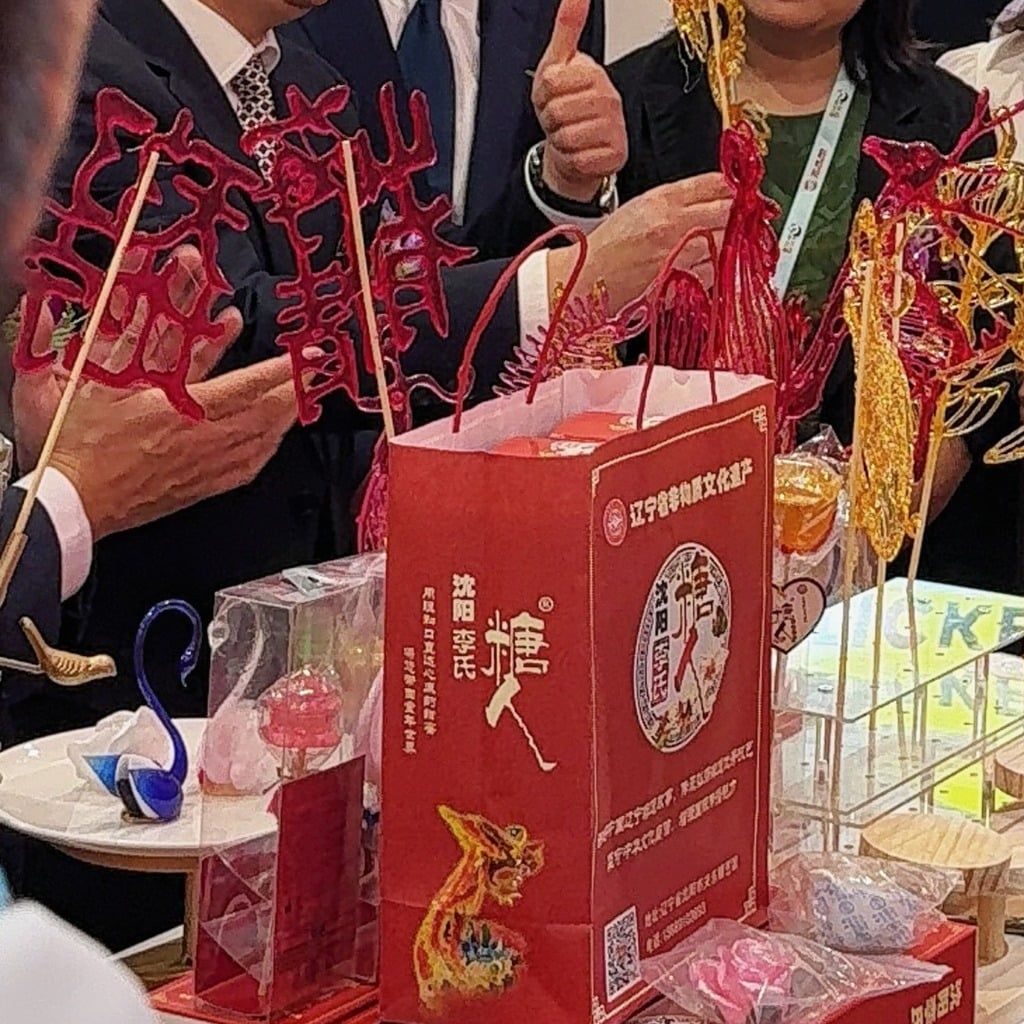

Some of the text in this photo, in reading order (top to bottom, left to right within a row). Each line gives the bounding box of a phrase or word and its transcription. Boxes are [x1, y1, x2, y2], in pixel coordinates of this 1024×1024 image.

[452, 573, 477, 680] 沈阳 李氏
[480, 609, 558, 771] 糖人
